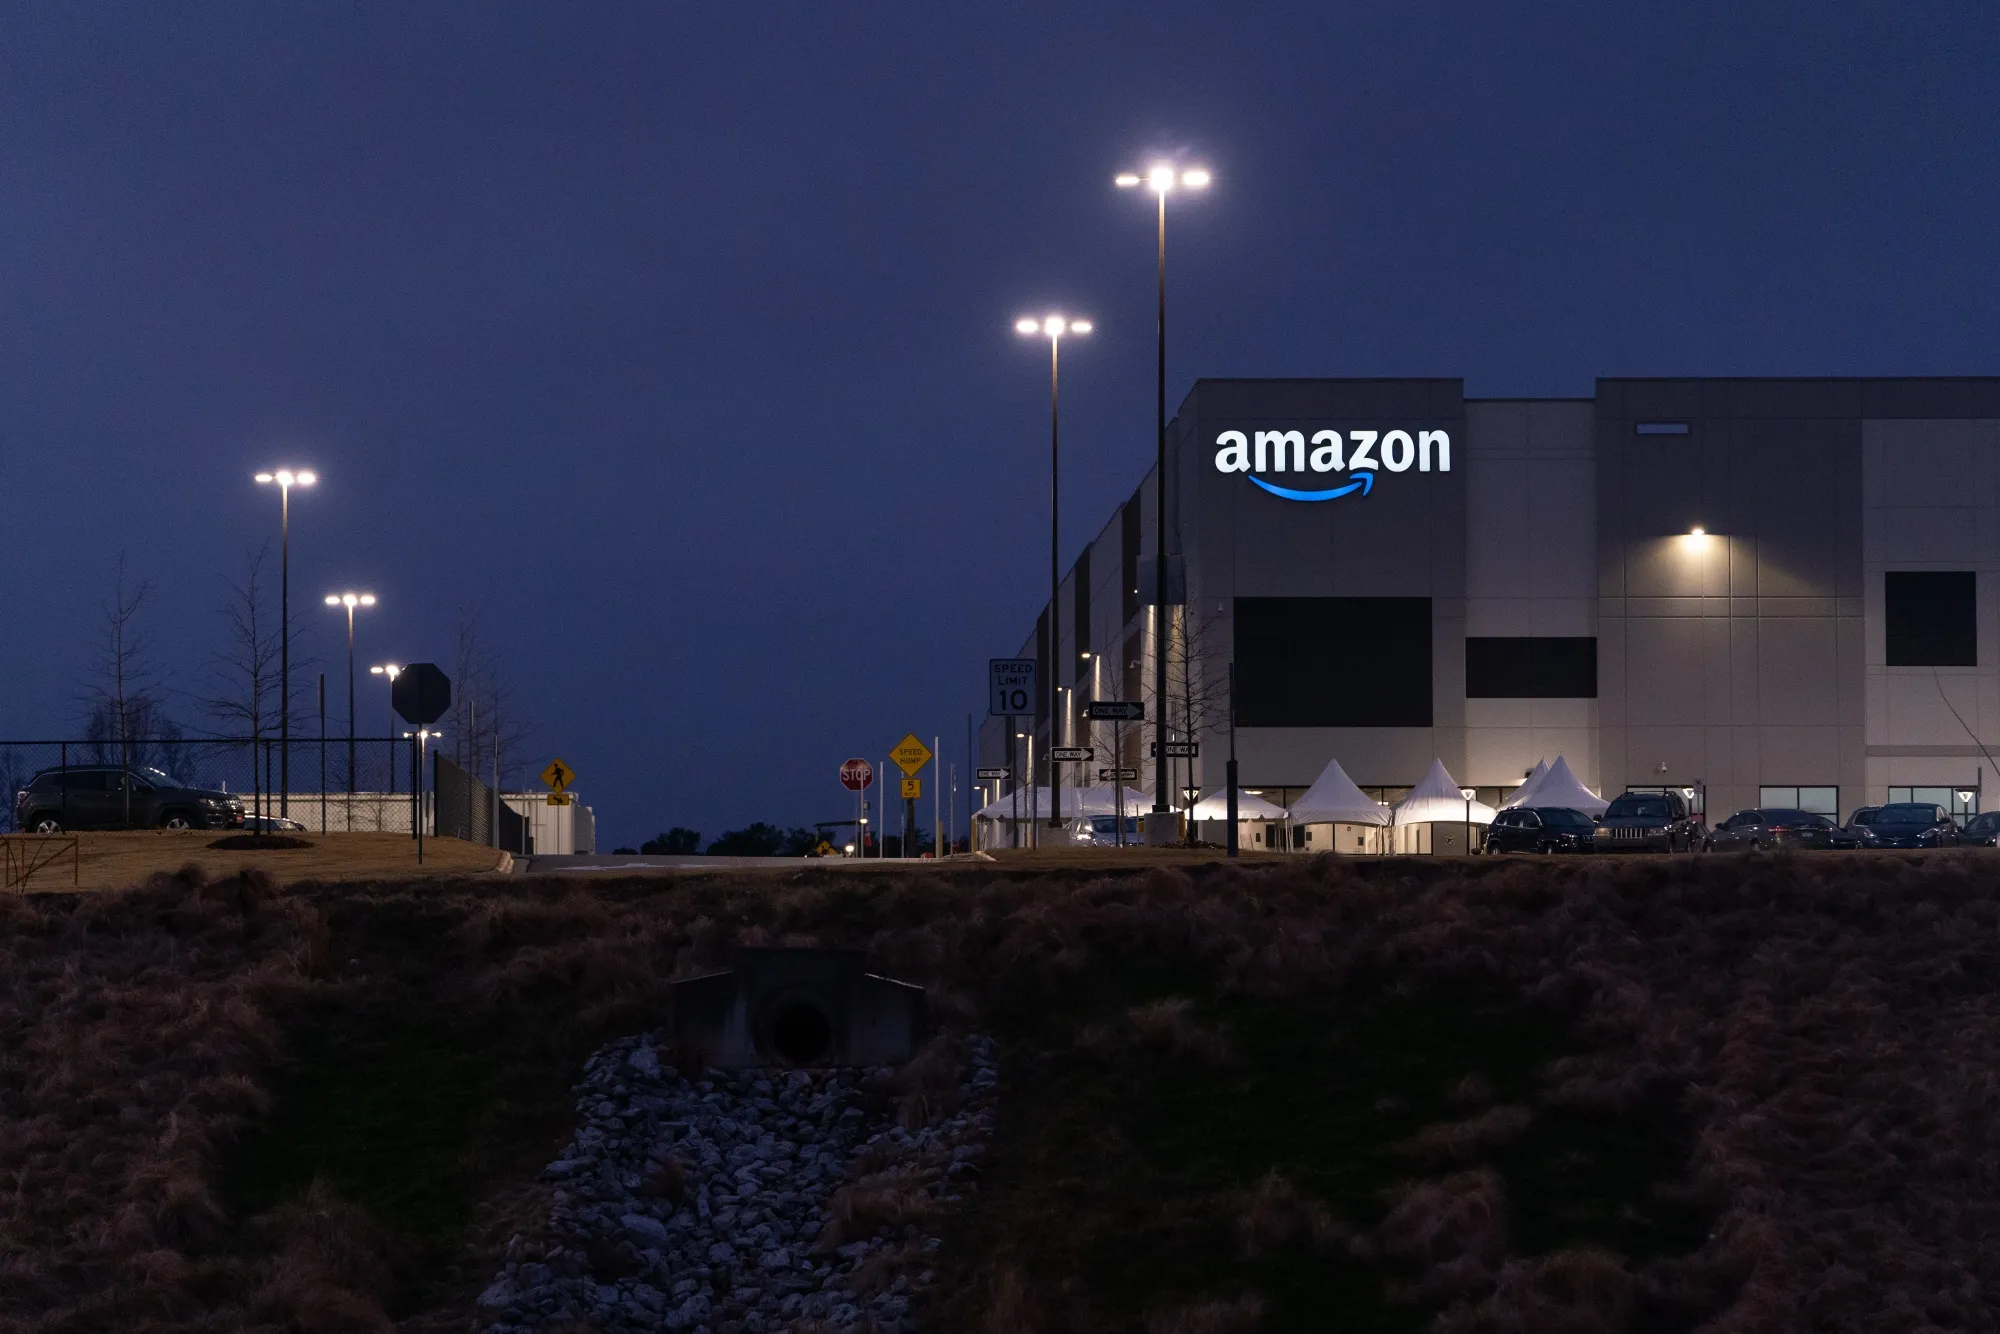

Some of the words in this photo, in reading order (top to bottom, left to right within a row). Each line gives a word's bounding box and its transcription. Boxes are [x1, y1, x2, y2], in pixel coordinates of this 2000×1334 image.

[1215, 430, 1450, 473] amazon
[994, 664, 1033, 673] SPEED
[999, 676, 1028, 685] LIMIT
[999, 690, 1027, 710] 10
[1094, 707, 1110, 715] ONE
[1112, 707, 1128, 715] WAY
[900, 748, 922, 756] SPEED
[843, 768, 870, 780] STOP
[907, 780, 915, 791] 5
